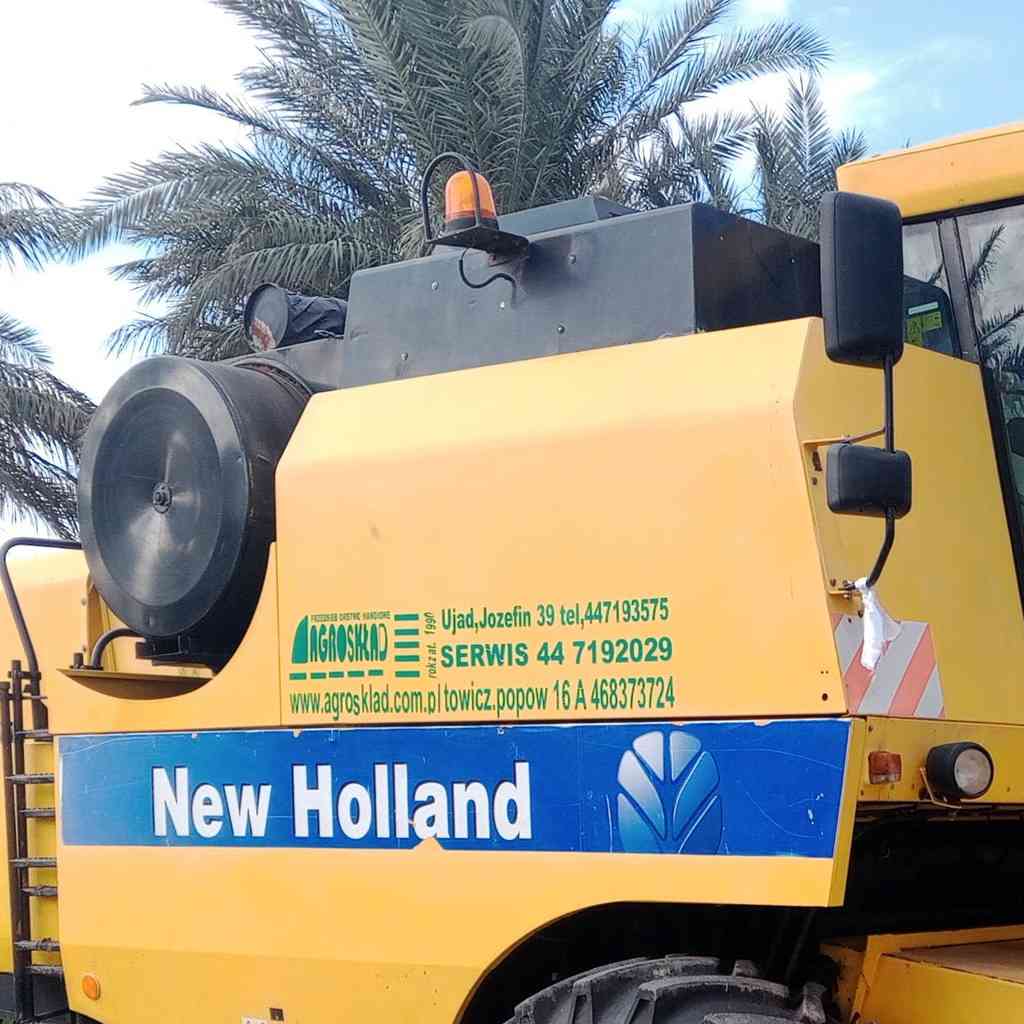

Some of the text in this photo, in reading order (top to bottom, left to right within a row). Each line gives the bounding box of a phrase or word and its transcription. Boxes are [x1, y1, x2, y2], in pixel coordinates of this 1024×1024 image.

[537, 604, 555, 627] 39
[560, 597, 669, 629] tel,447193575
[440, 636, 673, 668] SERWIS 44 7192029
[444, 681, 548, 717] towicz.popow
[553, 679, 571, 710] 16
[574, 679, 587, 710] A
[590, 676, 676, 710] 468373724
[152, 761, 533, 841] New Holland
